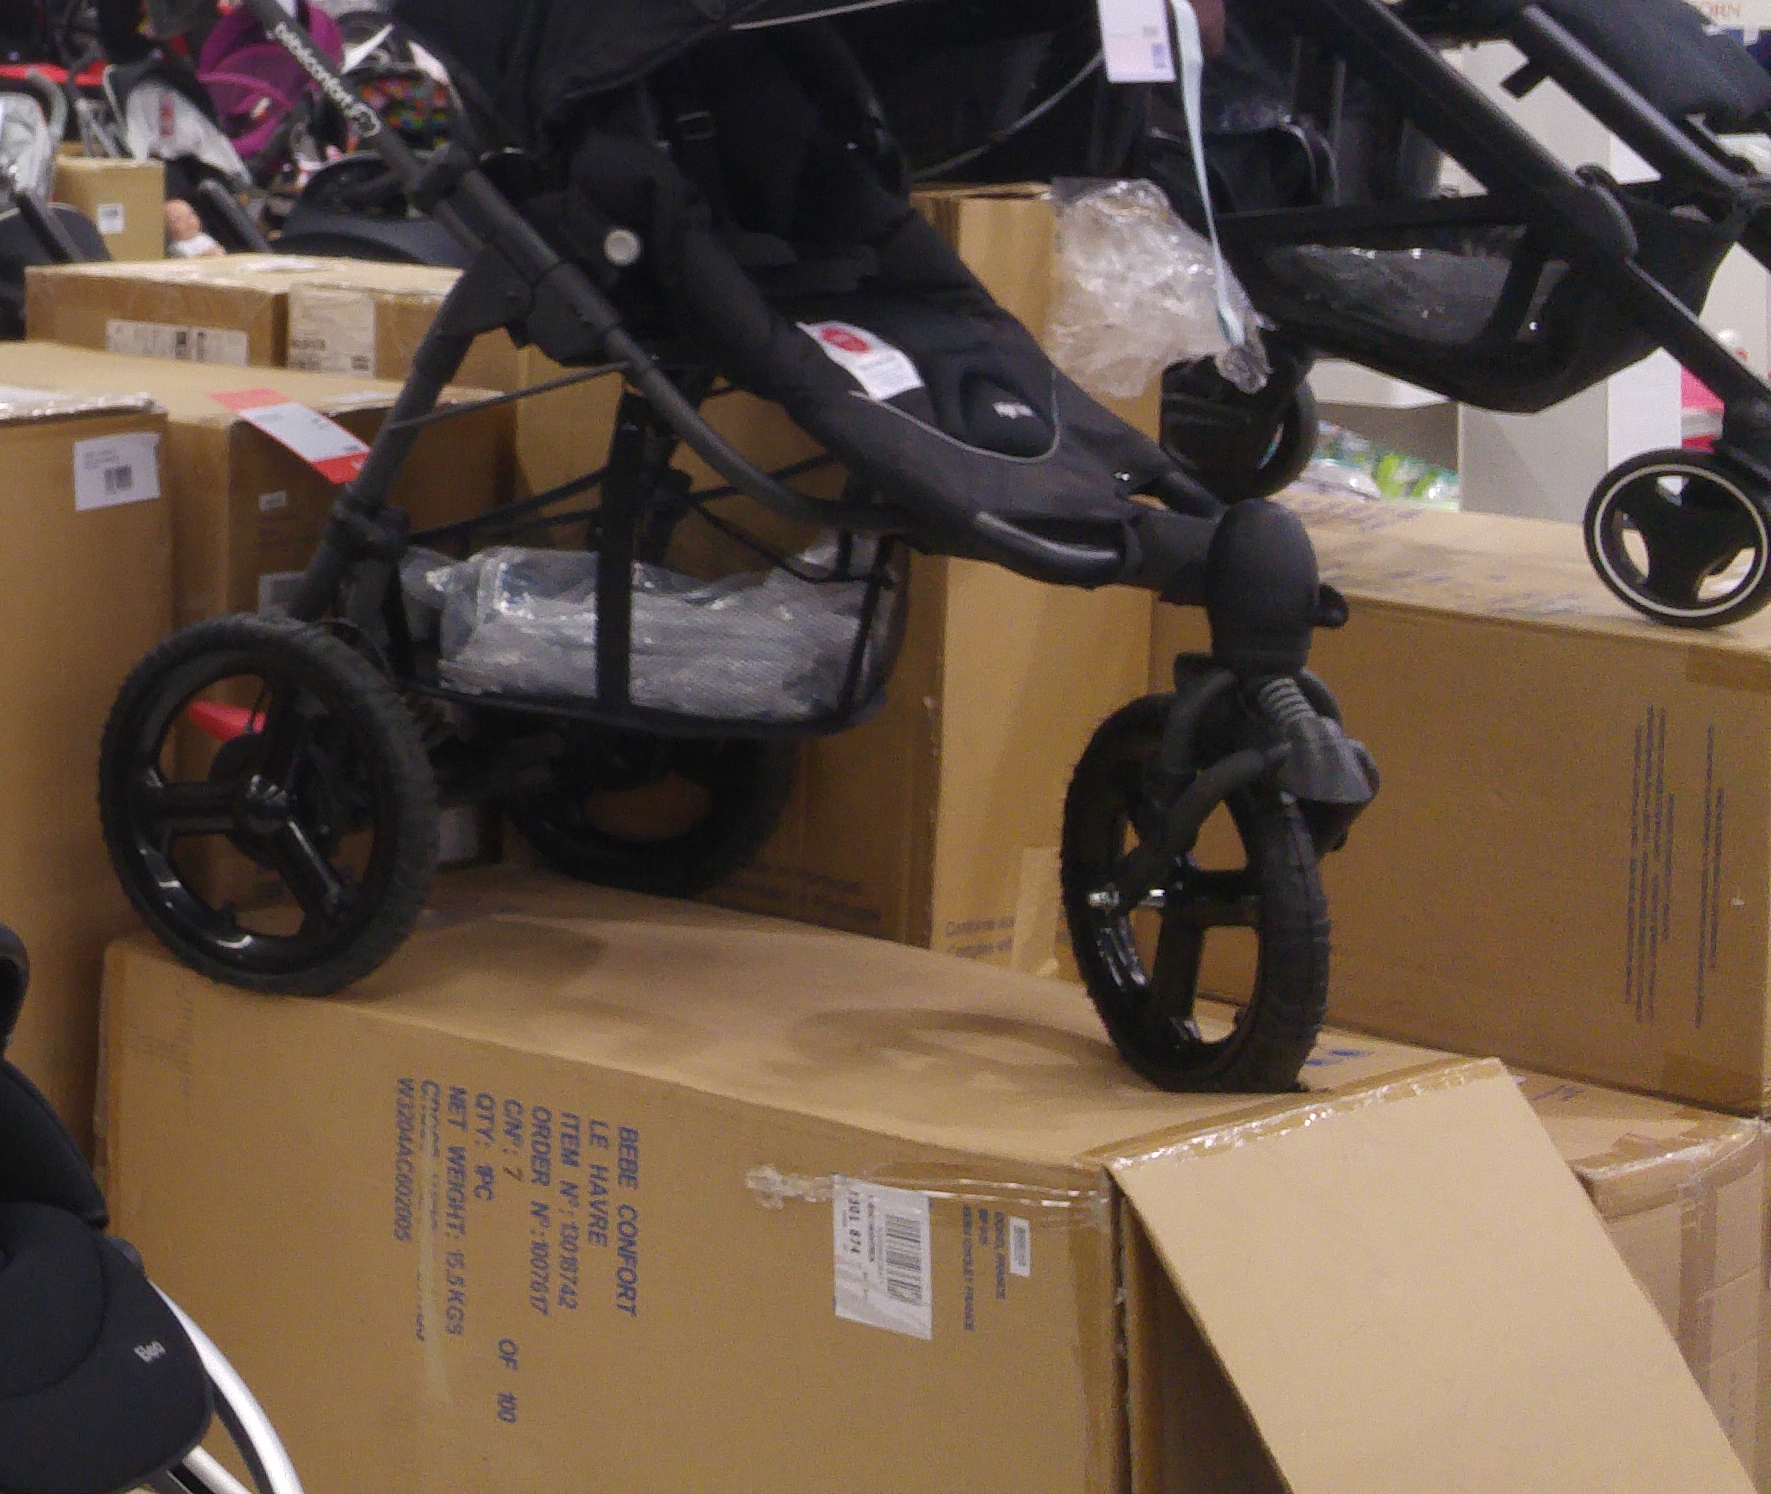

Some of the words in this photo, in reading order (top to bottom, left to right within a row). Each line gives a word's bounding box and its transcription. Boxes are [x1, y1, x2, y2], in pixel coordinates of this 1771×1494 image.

[448, 1087, 467, 1130] NET
[475, 1093, 494, 1147] QTY:
[588, 1120, 608, 1150] LE
[531, 1106, 551, 1186] ORDER
[560, 1112, 580, 1167] ITEM
[618, 1126, 638, 1190] BEBE
[445, 1145, 465, 1240] WEIGHT:
[587, 1164, 608, 1247] HAVRE
[616, 1204, 639, 1317] CONFORT
[498, 1339, 518, 1370] OF
[497, 1392, 518, 1423] 100
